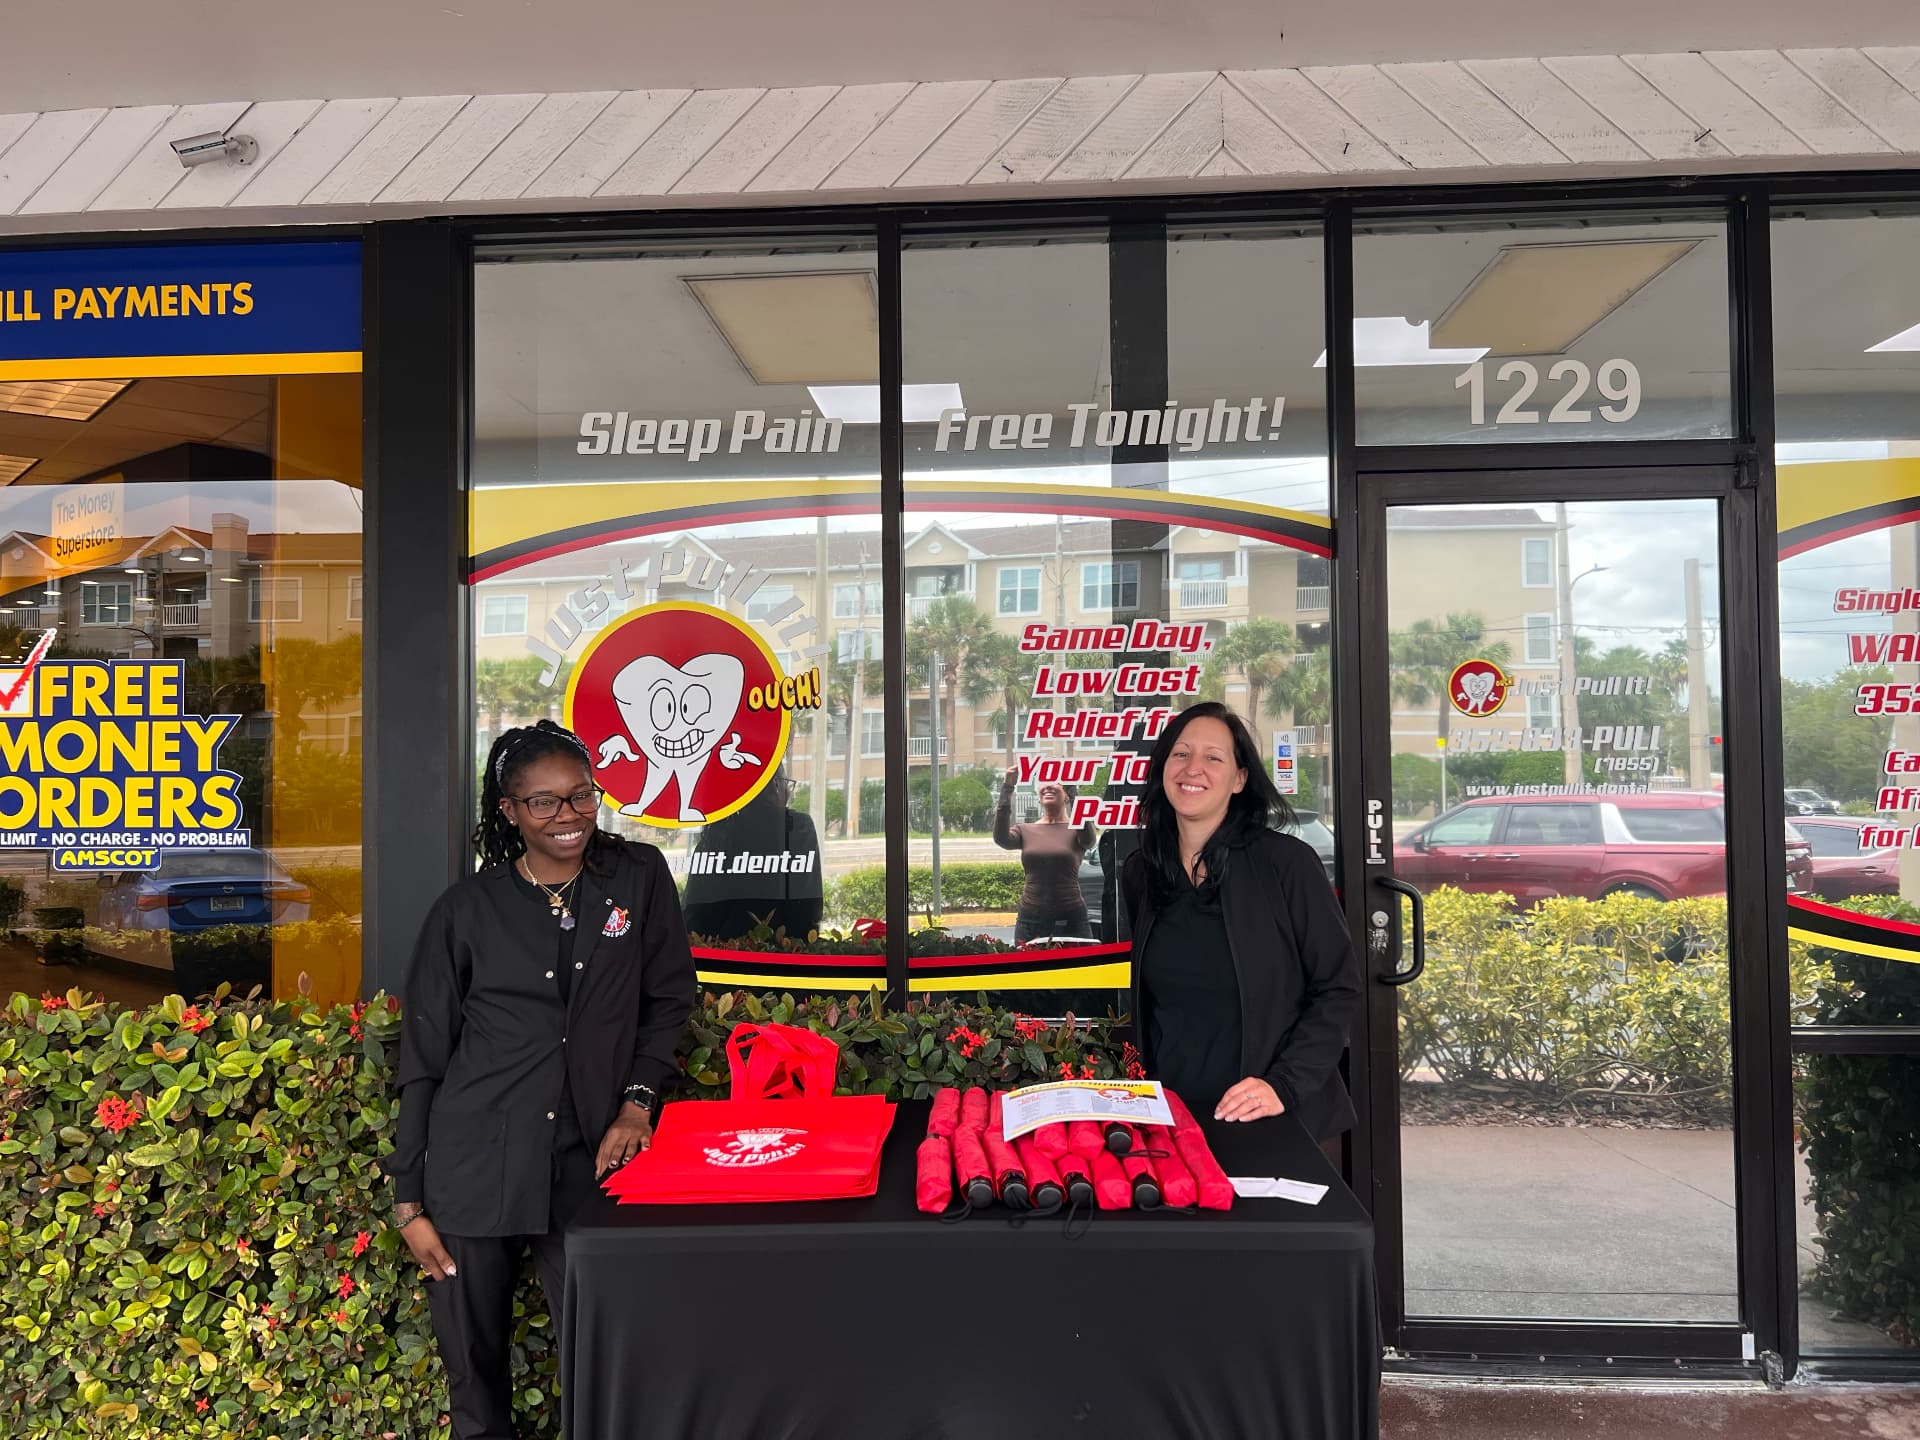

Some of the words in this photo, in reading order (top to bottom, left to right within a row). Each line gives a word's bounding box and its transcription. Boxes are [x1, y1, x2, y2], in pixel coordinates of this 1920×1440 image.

[53, 281, 254, 321] PAYMENTS
[1455, 358, 1641, 425] 1229
[576, 411, 722, 462] Sleep
[728, 409, 844, 454] Pain
[934, 407, 1054, 452] Free
[1066, 396, 1286, 452] Tonight!
[56, 501, 75, 525] The
[78, 488, 115, 518] Money
[56, 524, 115, 559] Superstore
[647, 546, 772, 606] Pull
[1020, 623, 1127, 653] Same
[1130, 620, 1213, 653] Day,
[1850, 633, 1920, 665] WA
[39, 665, 179, 717] FREE
[747, 667, 821, 712] OUCH!
[1034, 665, 1114, 697] Low
[1115, 663, 1203, 696] Cost
[1508, 678, 1570, 696] Just
[1573, 677, 1622, 696] Pull
[1624, 676, 1654, 696] It!
[1024, 707, 1142, 740] Relief
[0, 719, 230, 774] MONEY
[1016, 753, 1105, 785] Your
[0, 775, 238, 830] ORDERS
[1878, 787, 1920, 811] Af
[1, 832, 38, 846] LIMIT
[52, 832, 77, 846] NO
[80, 832, 140, 846] CHARGE
[151, 832, 176, 846] NO
[179, 832, 247, 846] PROBLEM
[1367, 799, 1384, 859] PULL
[1860, 825, 1910, 849] for
[60, 850, 154, 866] AMSCOT
